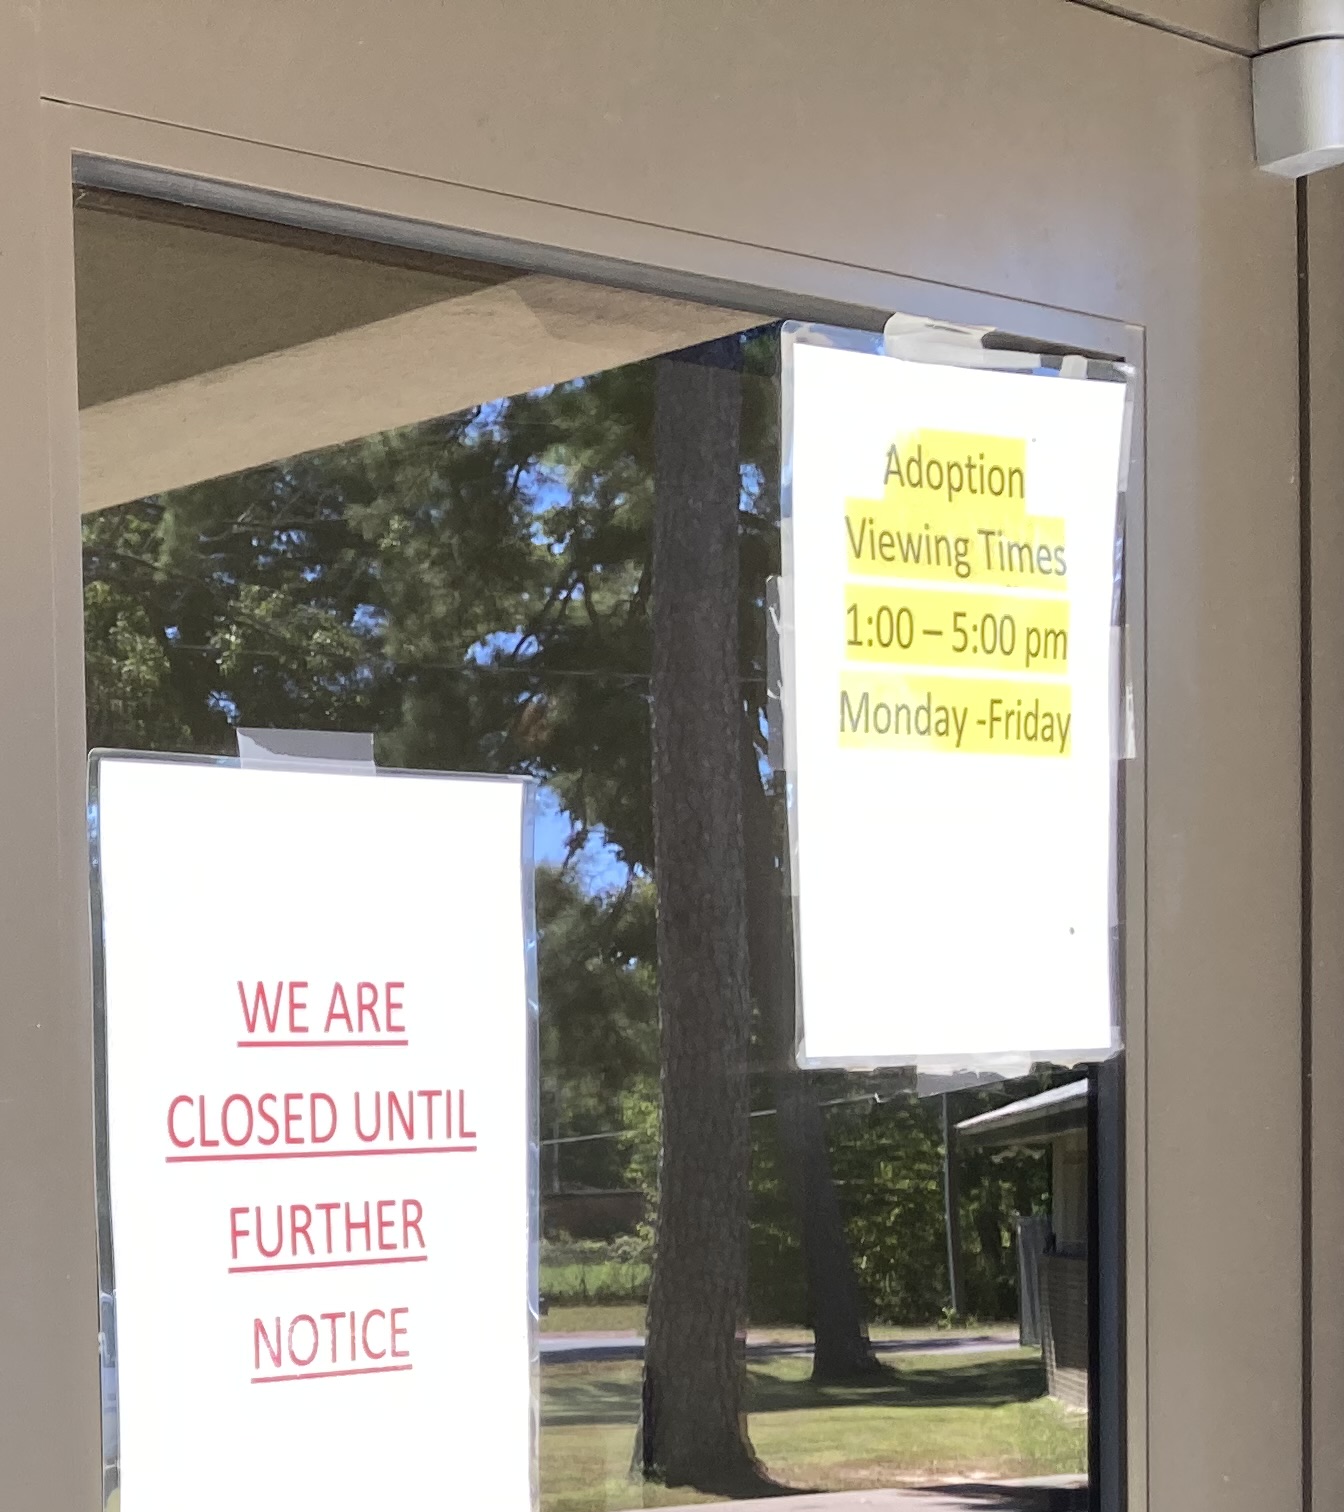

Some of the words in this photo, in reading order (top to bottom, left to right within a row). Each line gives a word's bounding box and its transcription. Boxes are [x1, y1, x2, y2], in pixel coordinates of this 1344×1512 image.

[884, 443, 1025, 502] Adoption
[845, 514, 971, 578] Viewing
[977, 528, 1067, 576] Times
[847, 603, 914, 649] 1:00
[952, 611, 1016, 656] 5:00
[1026, 627, 1068, 668] pm
[840, 689, 968, 748] Monday
[976, 698, 1071, 754] -Friday
[237, 981, 308, 1034] WE
[324, 981, 406, 1034] ARE
[166, 1092, 338, 1150] CLOSED
[355, 1088, 476, 1141] UNTIL
[229, 1199, 426, 1260] FURTHER
[253, 1308, 410, 1370] NOTICE
